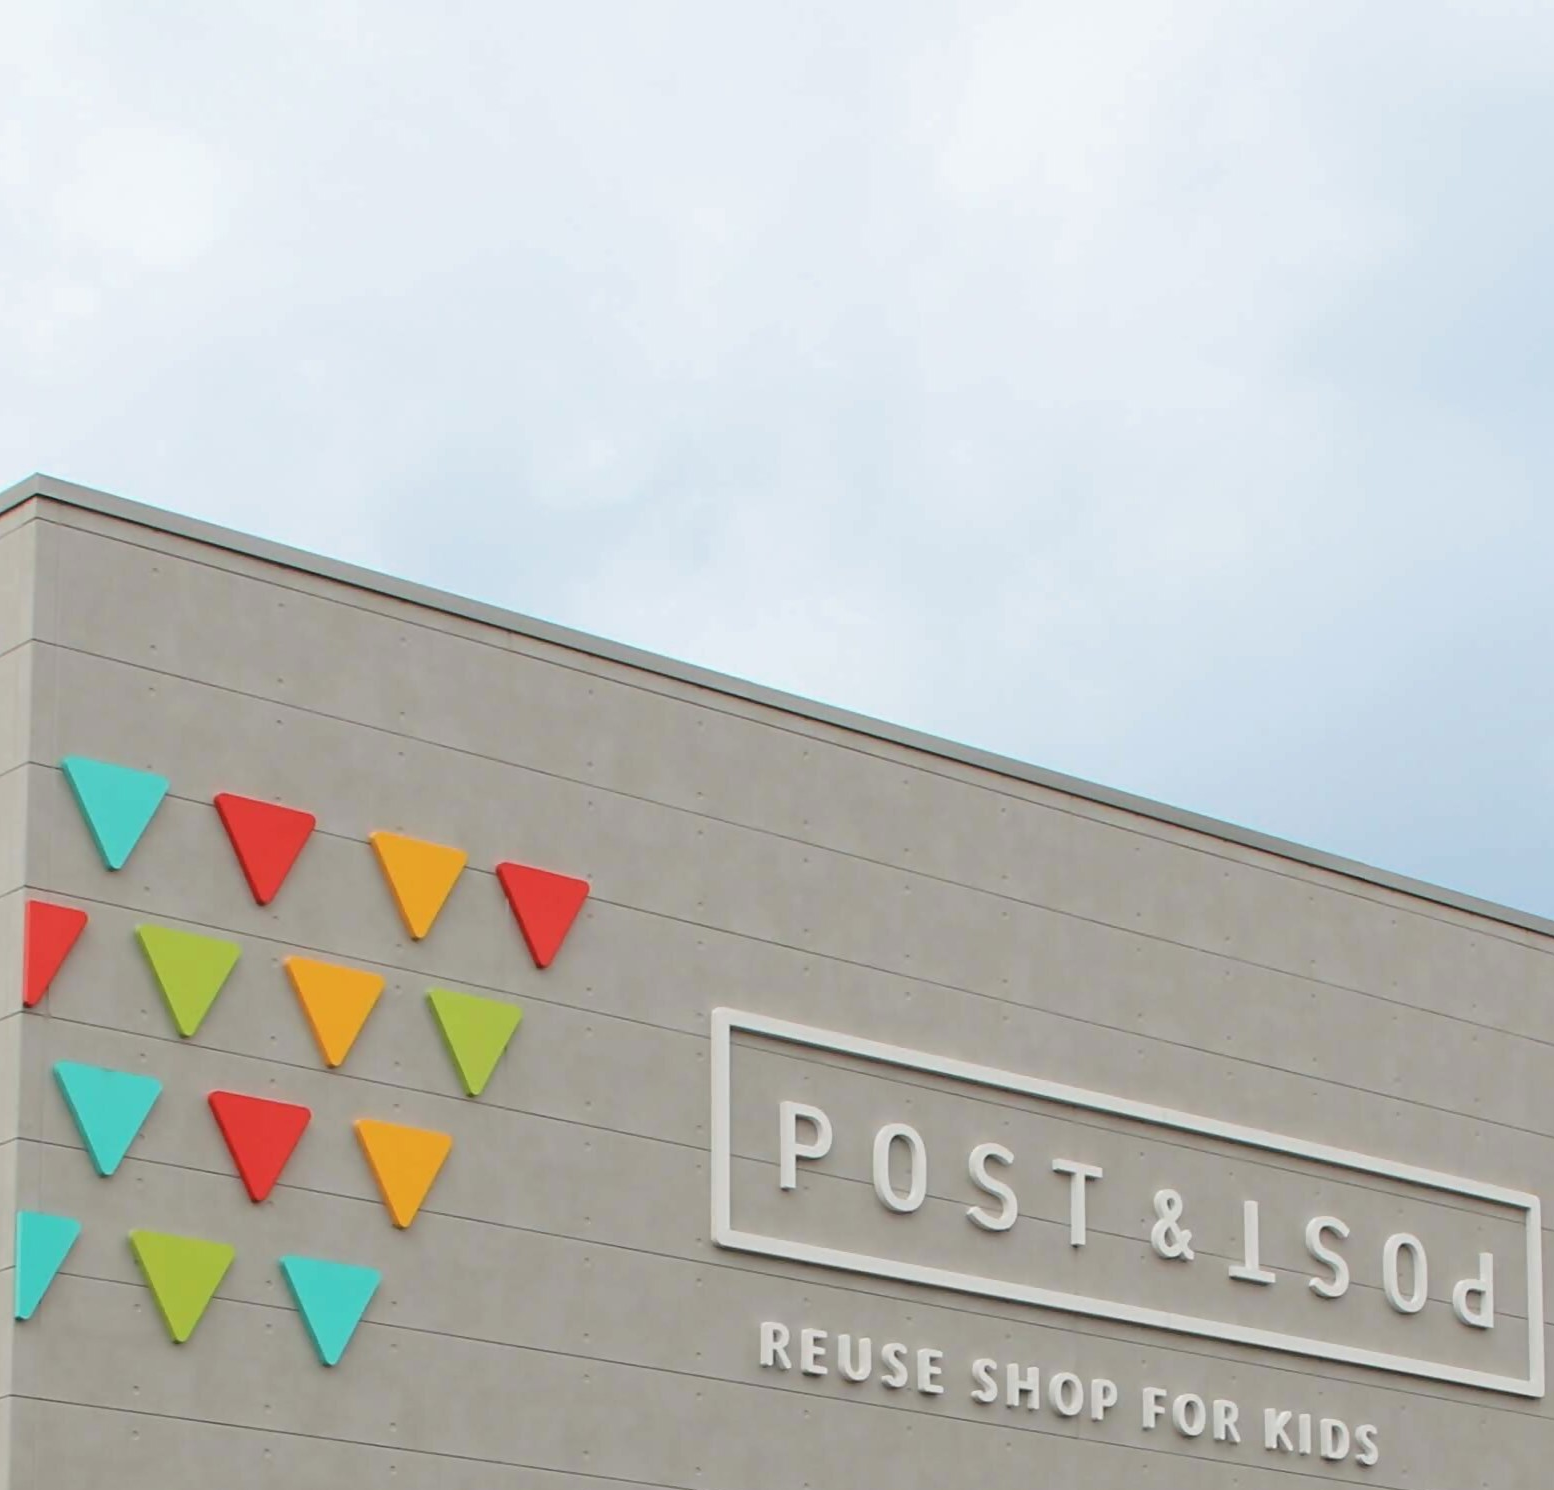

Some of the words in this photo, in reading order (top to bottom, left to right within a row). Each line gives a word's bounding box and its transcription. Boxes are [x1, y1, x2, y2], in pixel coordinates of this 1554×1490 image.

[778, 1100, 1104, 1249] POST
[759, 1320, 946, 1397] REUSE
[970, 1358, 1120, 1424] SHOP
[1142, 1386, 1243, 1447] FOR
[1264, 1407, 1382, 1469] KIDS
